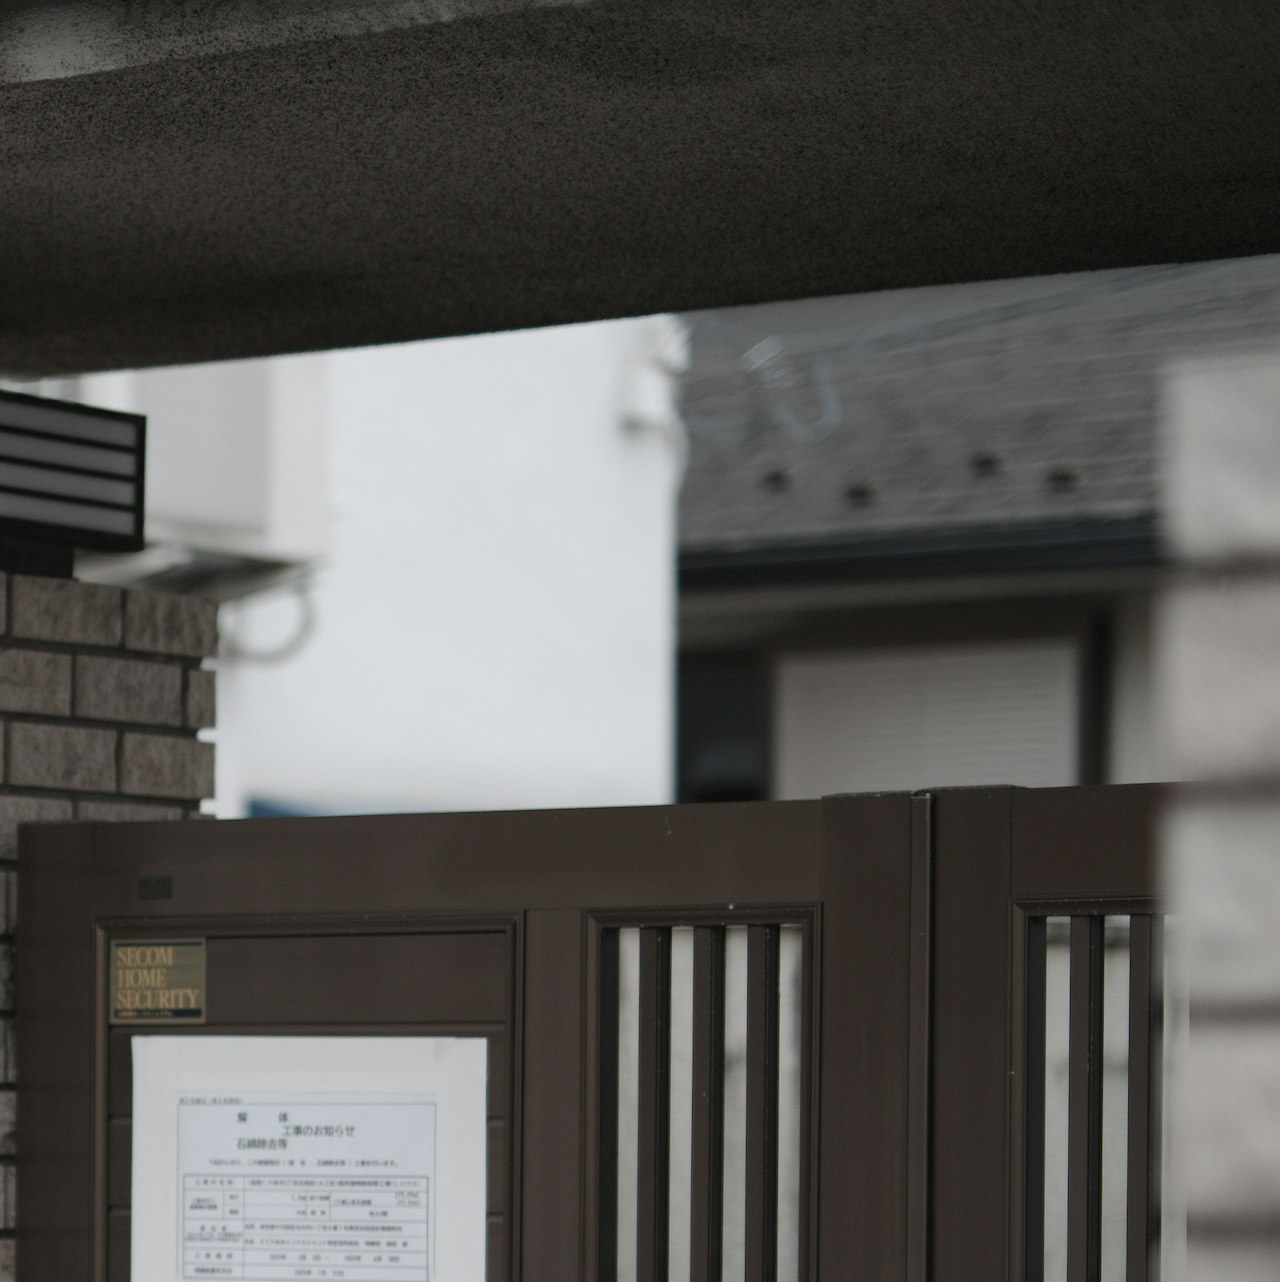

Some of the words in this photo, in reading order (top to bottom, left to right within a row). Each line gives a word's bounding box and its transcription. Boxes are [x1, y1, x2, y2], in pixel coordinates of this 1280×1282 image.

[117, 946, 173, 967] SECOM
[118, 968, 167, 988] HOME
[117, 988, 198, 1009] SECURITY
[282, 1125, 355, 1137] 工事のお知らせ
